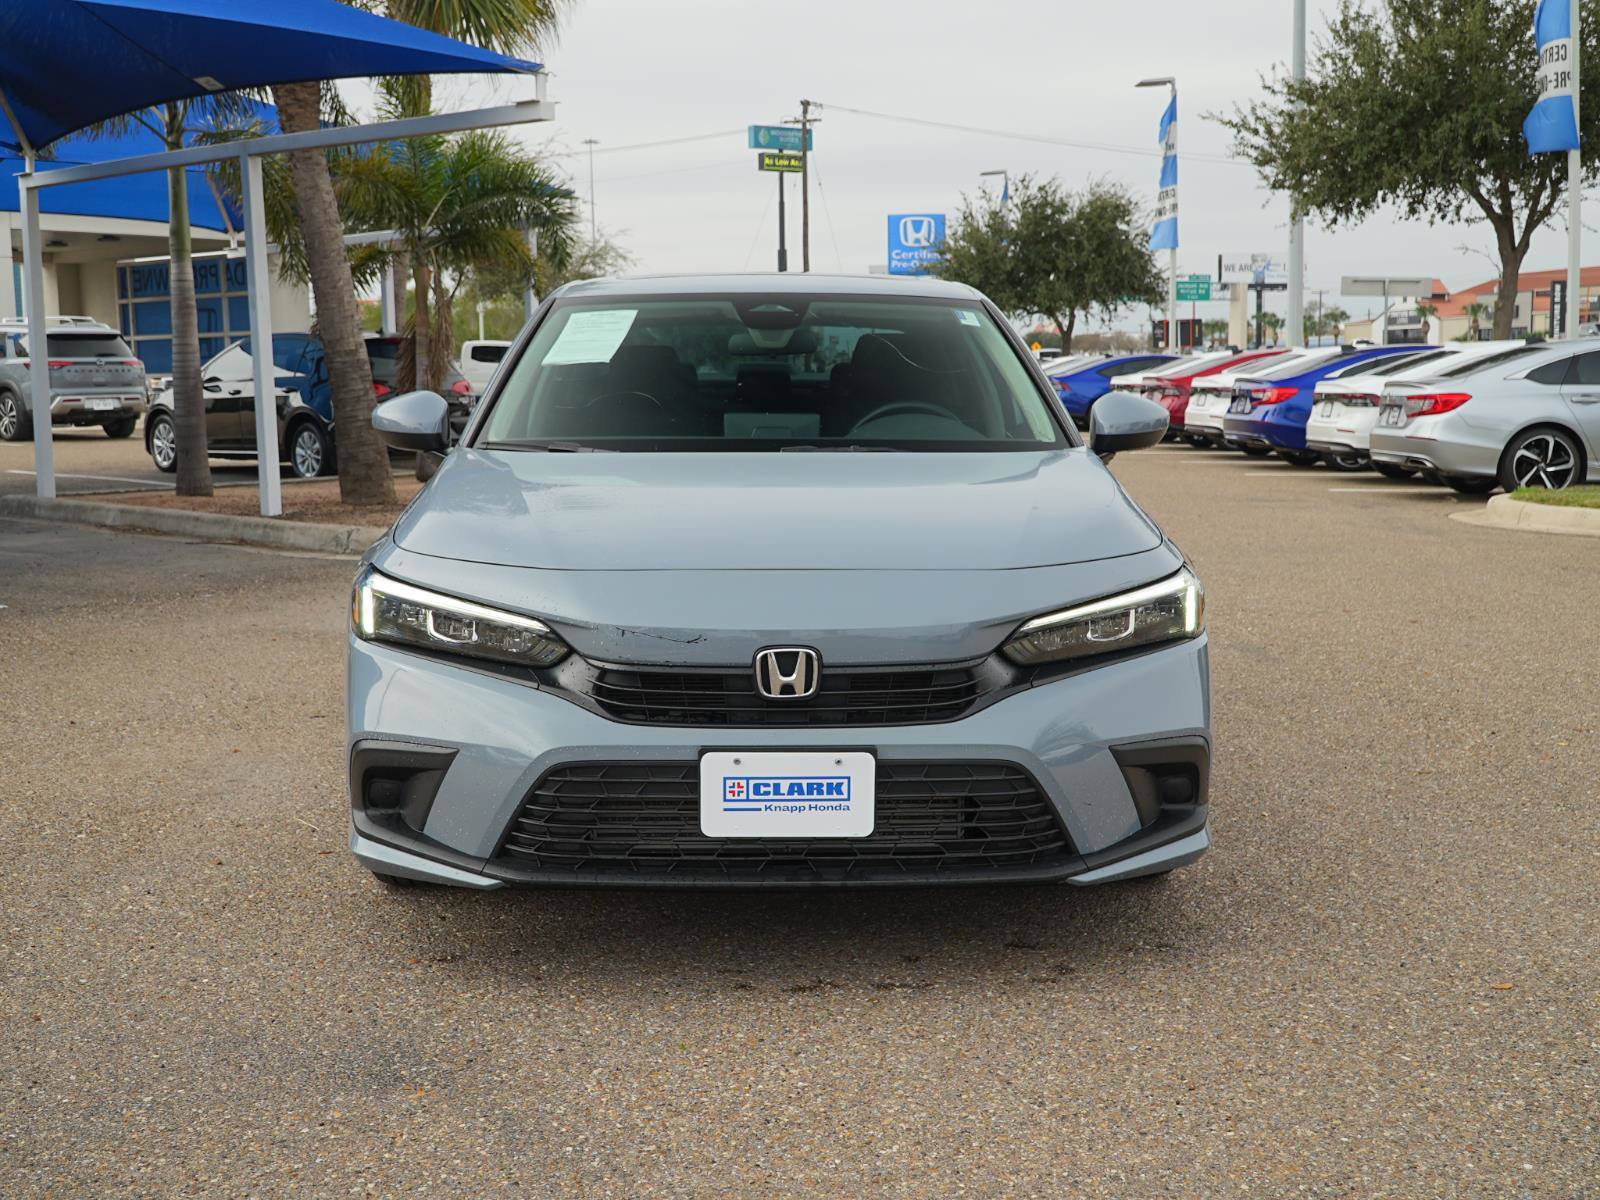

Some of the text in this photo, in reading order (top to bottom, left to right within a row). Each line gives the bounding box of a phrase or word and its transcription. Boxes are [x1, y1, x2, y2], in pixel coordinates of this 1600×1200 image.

[752, 782, 845, 796] CLARK
[764, 803, 850, 813] Knapp Honda
